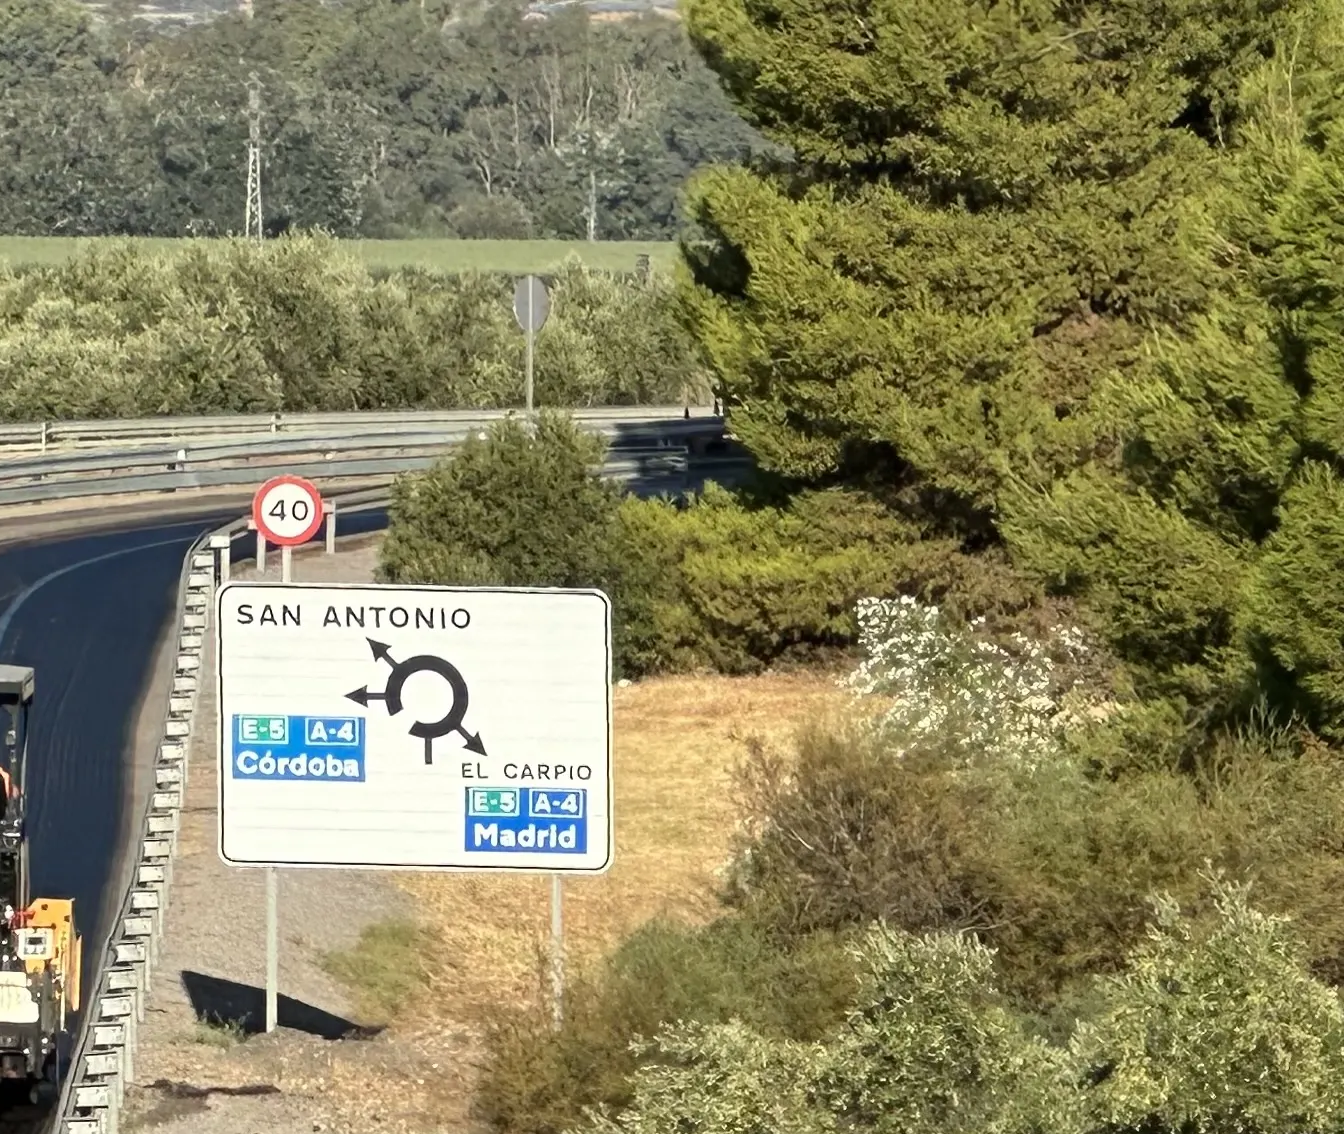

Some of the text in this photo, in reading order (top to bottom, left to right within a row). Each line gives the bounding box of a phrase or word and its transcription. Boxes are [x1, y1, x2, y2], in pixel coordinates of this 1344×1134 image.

[268, 499, 309, 521] 40
[237, 604, 471, 629] SAN ANTONIO
[242, 718, 354, 742] E-5 A-4
[236, 749, 359, 777] Córdoba
[461, 762, 592, 780] EL CARPIO
[473, 791, 578, 814] E-5 A-4
[474, 822, 576, 849] Madrid
